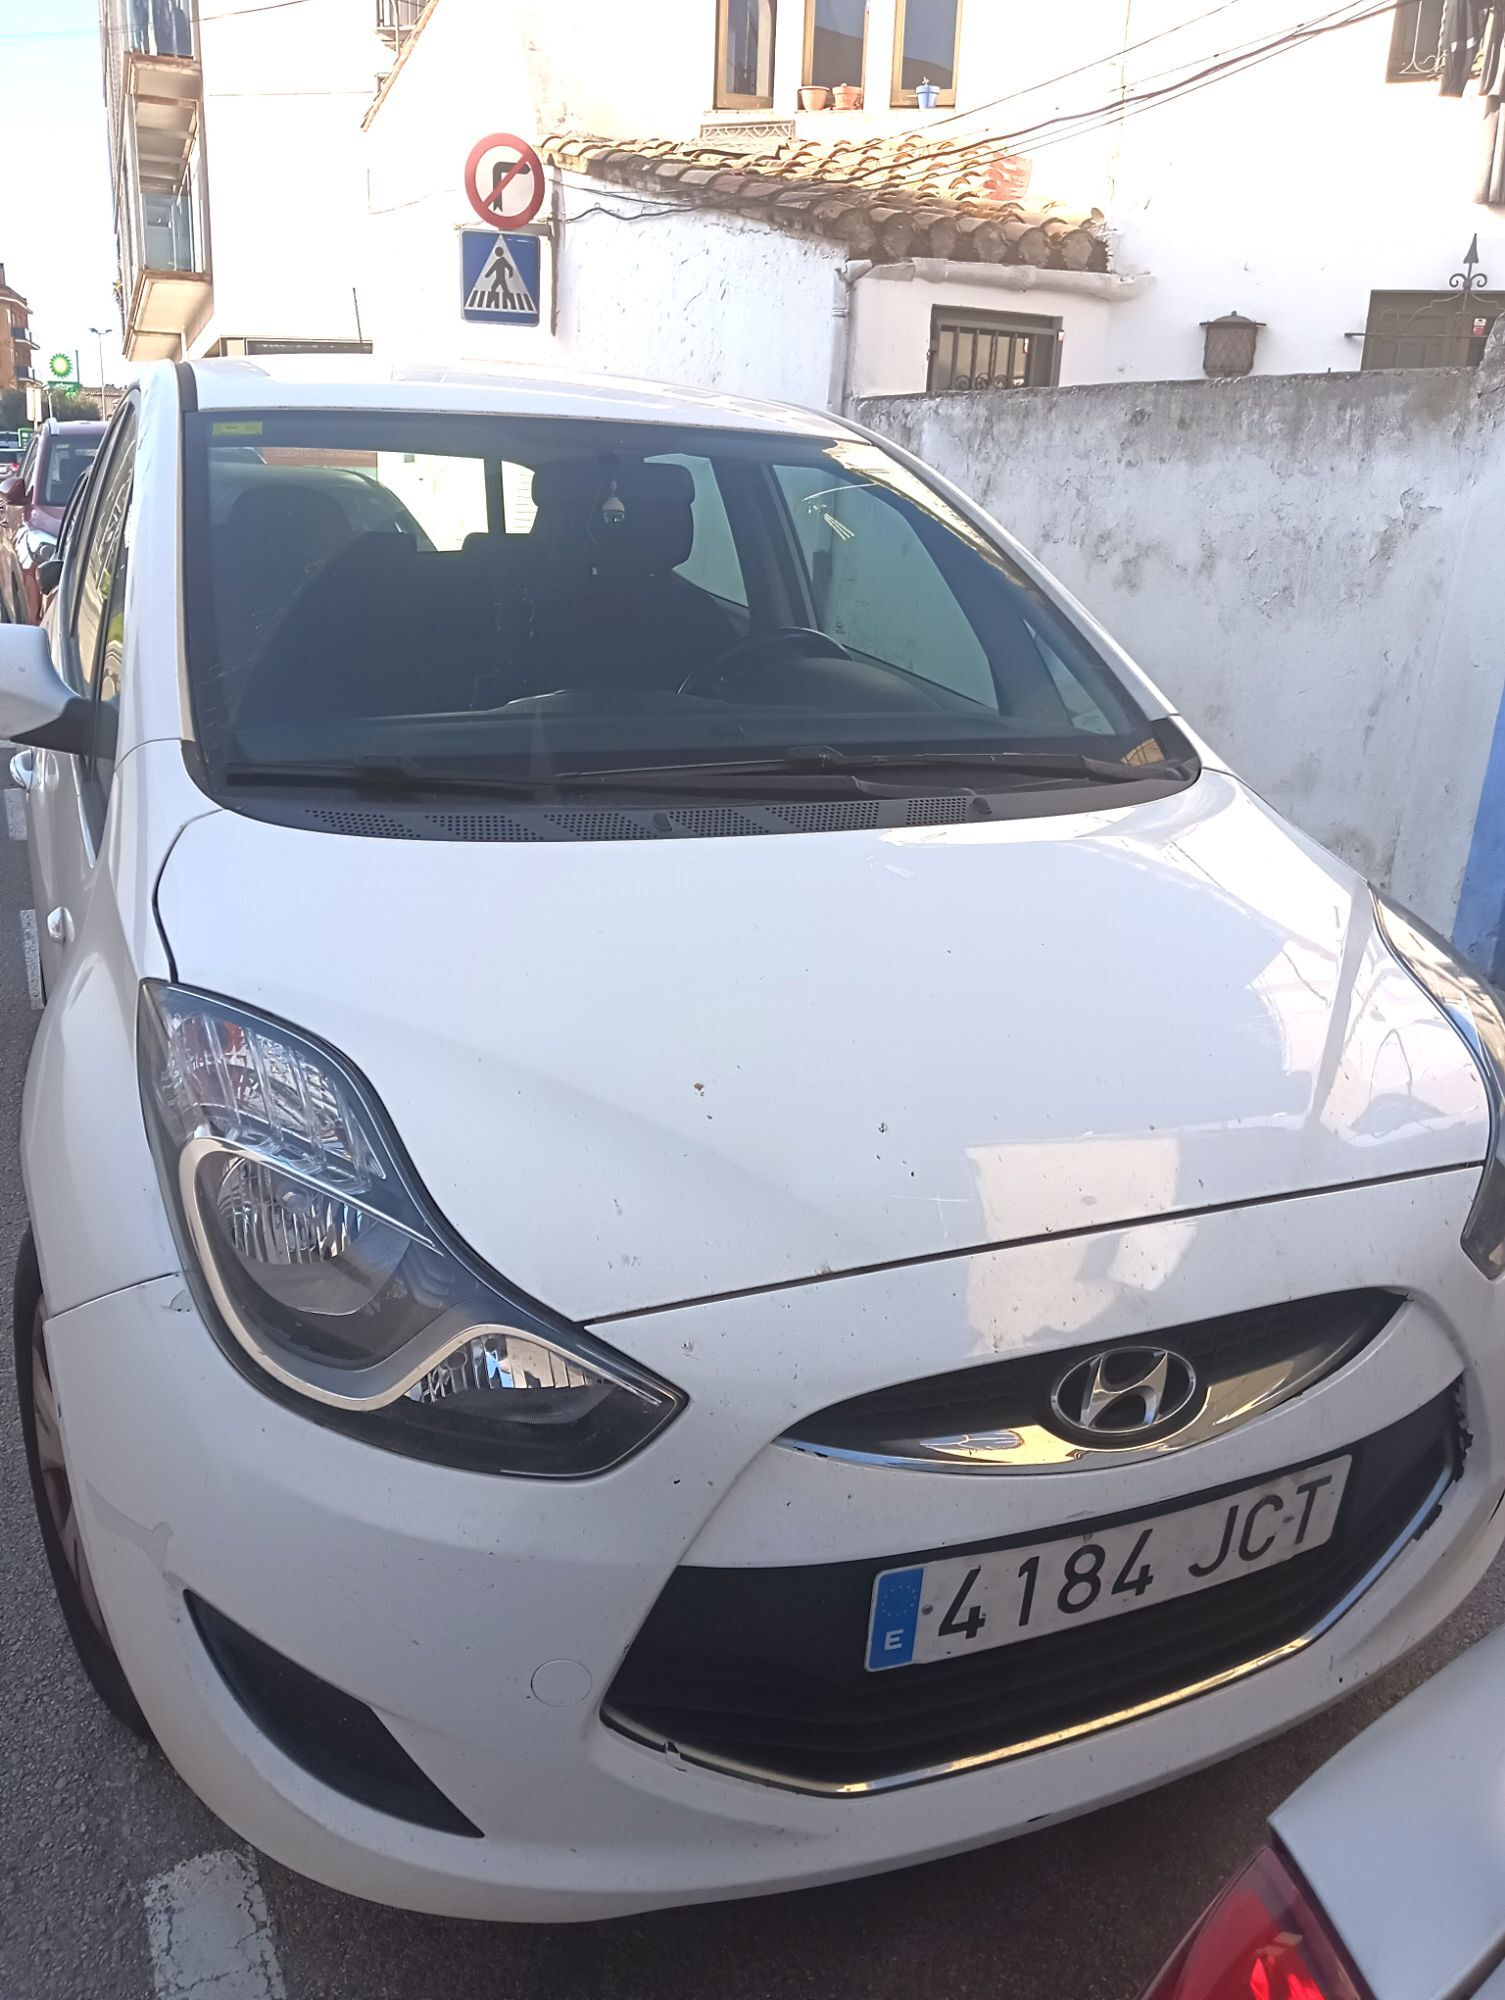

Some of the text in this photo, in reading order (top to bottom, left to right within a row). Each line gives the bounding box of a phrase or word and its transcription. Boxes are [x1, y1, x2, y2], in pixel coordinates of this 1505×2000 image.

[937, 1474, 1333, 1640] 4184 JCT
[884, 1628, 905, 1651] E
